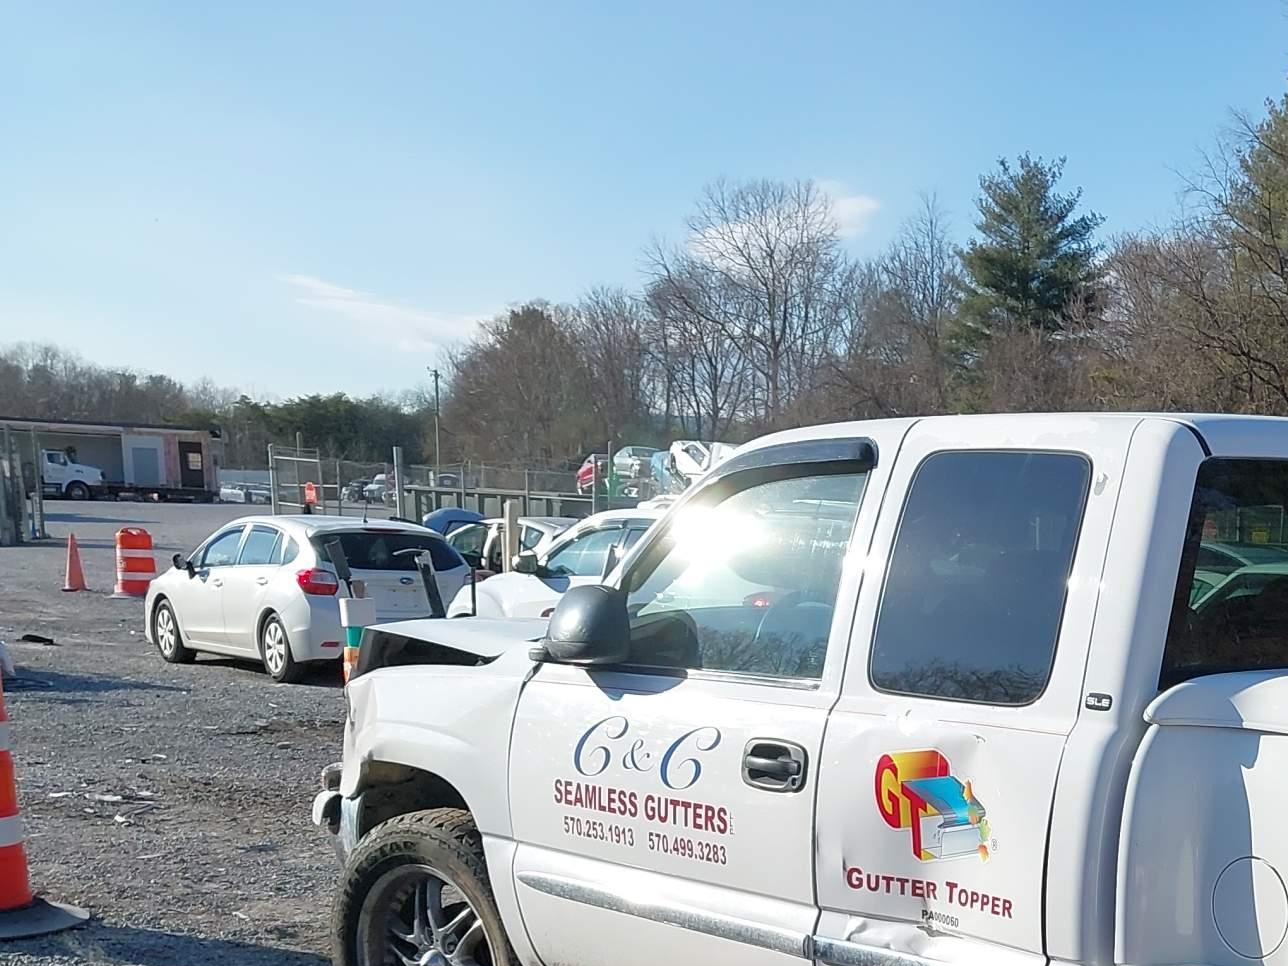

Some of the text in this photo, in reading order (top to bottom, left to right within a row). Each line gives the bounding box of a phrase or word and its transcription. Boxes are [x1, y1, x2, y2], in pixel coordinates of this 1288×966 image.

[1086, 696, 1111, 707] SLE
[573, 715, 722, 790] C & C
[553, 778, 728, 835] SEAMLESS GUTTERS
[563, 815, 728, 865] 570.253.1913 570.499.3283
